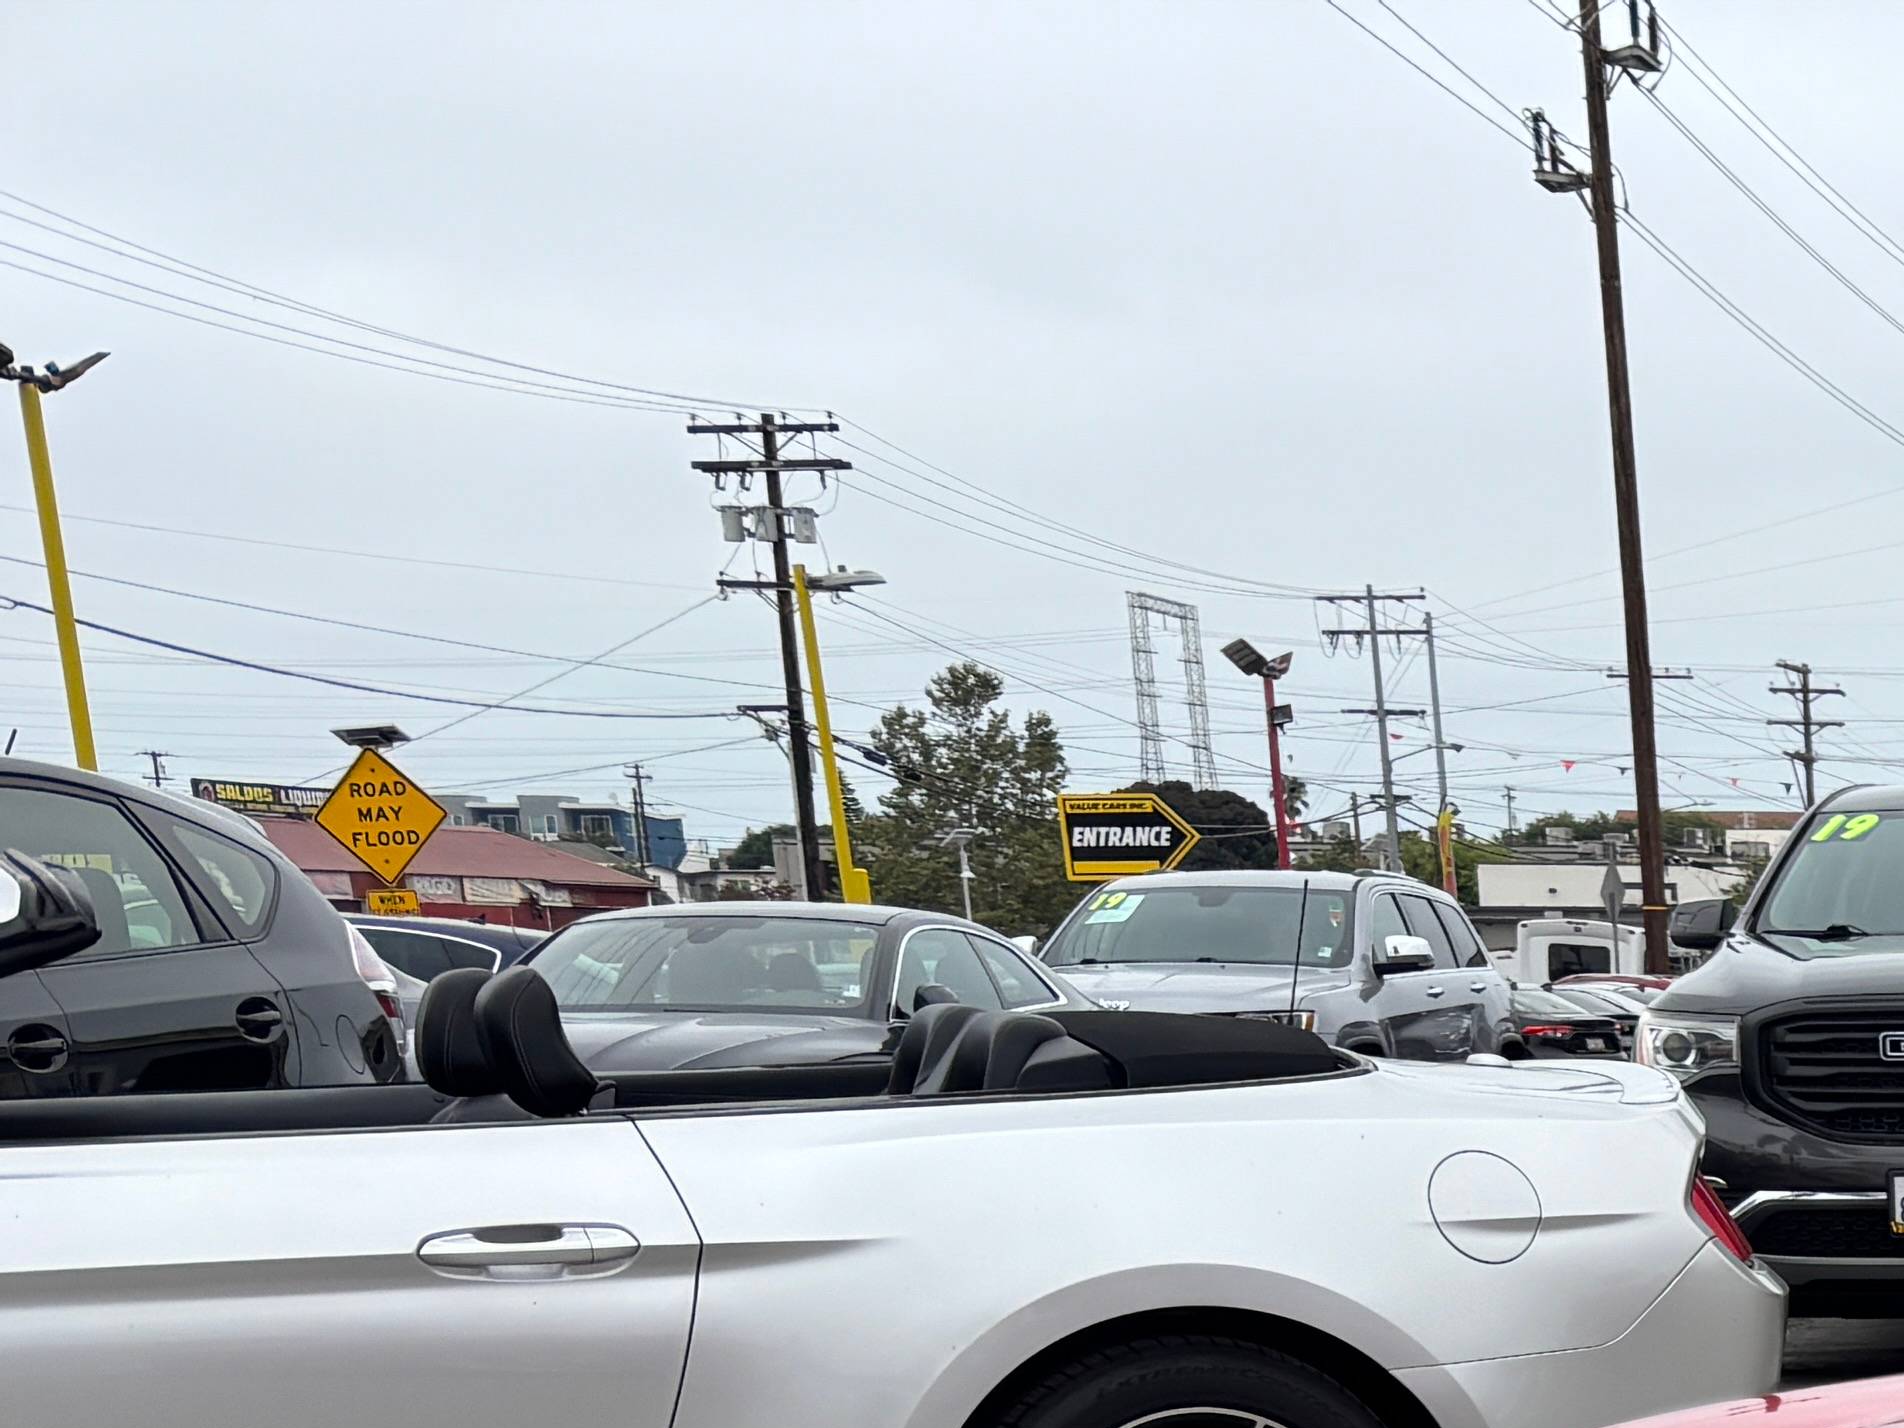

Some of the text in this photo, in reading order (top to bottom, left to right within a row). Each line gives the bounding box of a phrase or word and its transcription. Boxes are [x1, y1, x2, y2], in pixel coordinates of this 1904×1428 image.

[215, 784, 273, 802] SALDOS
[350, 781, 406, 798] ROAD
[358, 806, 403, 822] MAY
[1810, 813, 1880, 841] 19
[352, 831, 420, 848] FLOOD
[1072, 826, 1172, 847] ENTRANCE
[1088, 891, 1127, 911] 19
